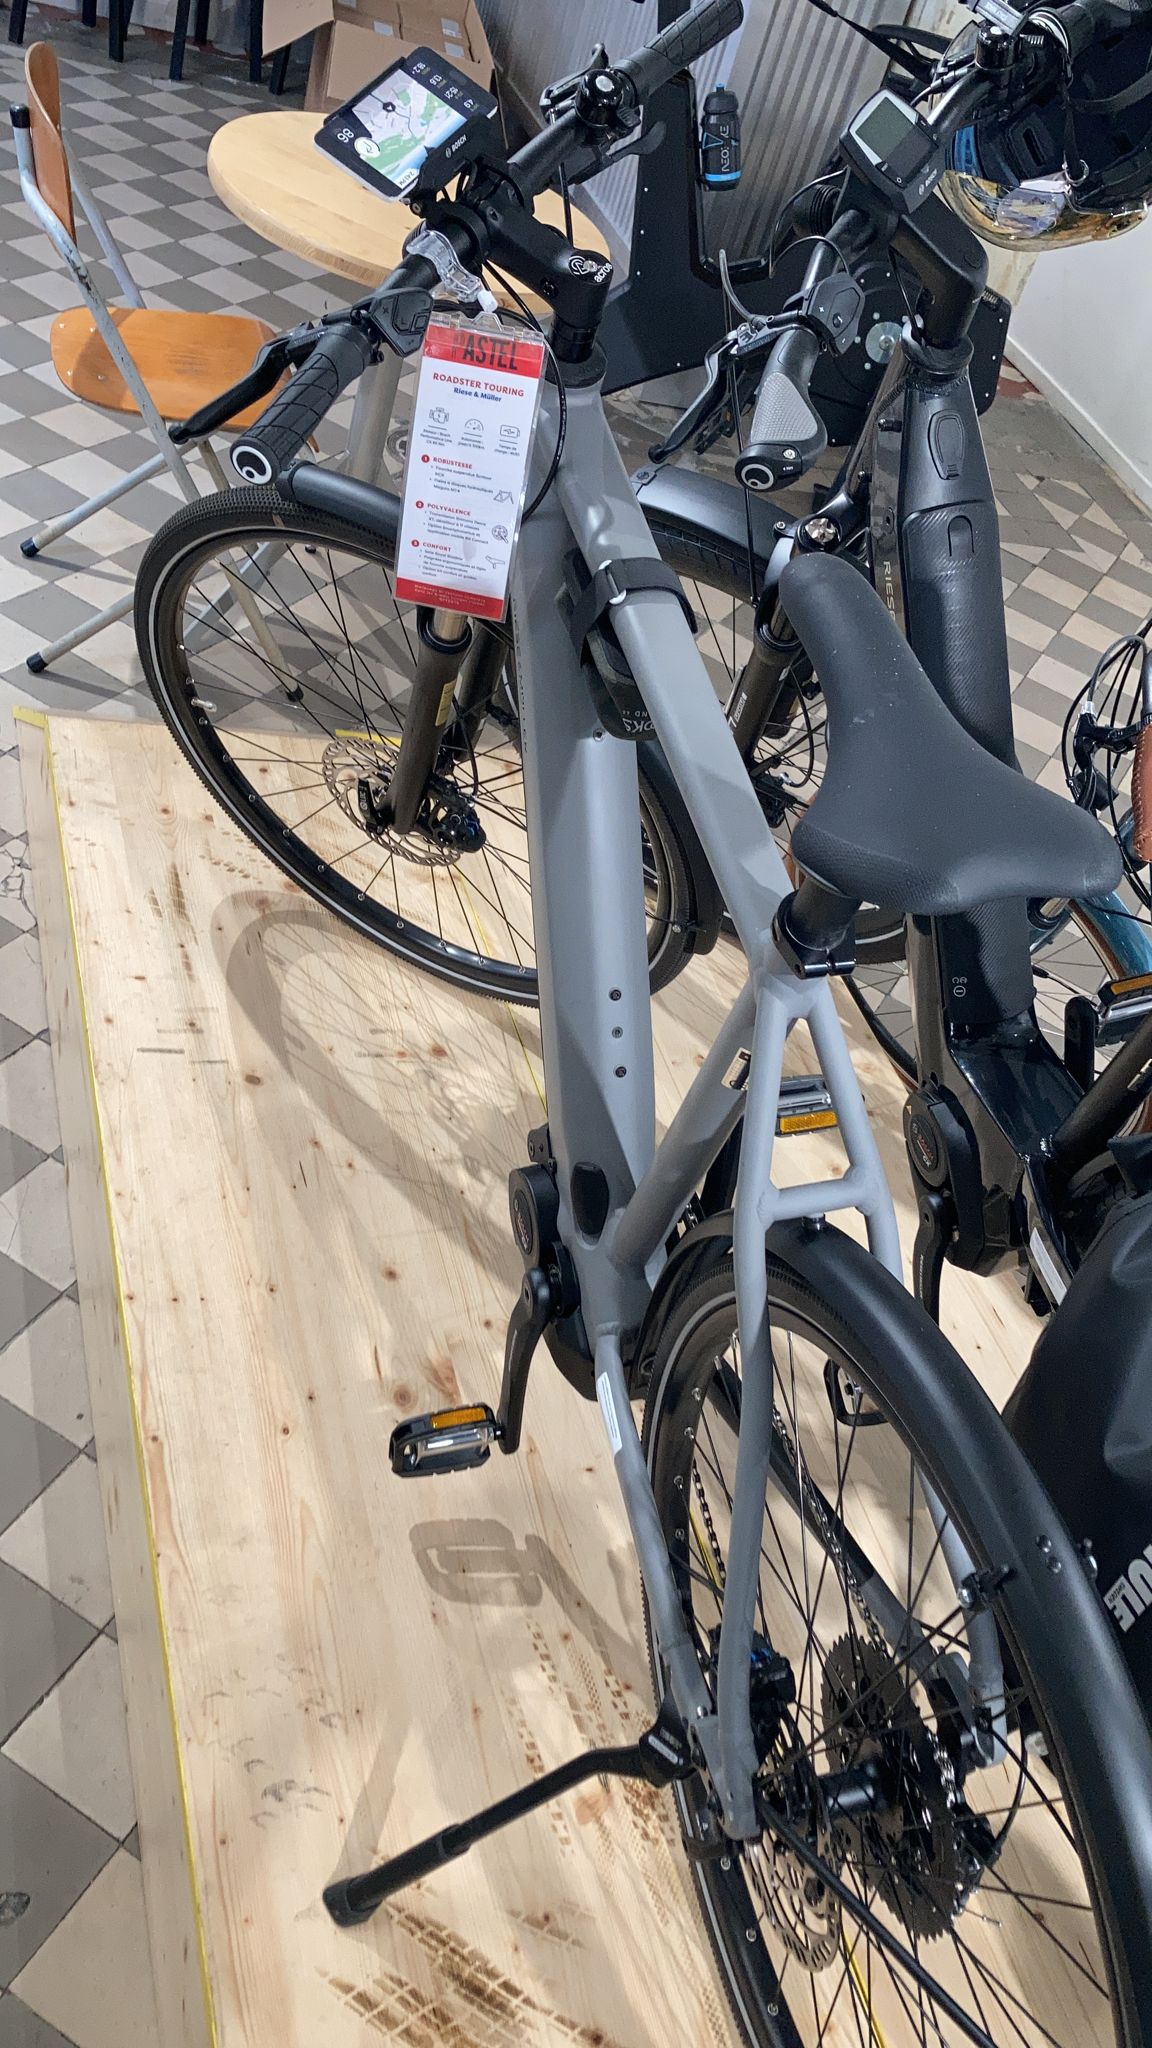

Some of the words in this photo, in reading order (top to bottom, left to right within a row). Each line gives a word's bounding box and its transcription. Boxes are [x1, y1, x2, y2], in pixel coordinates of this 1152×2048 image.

[451, 134, 468, 153] BOSCH
[451, 332, 518, 370] PASTEL
[433, 372, 482, 389] ROADSTER
[484, 382, 525, 397] TOURING
[453, 387, 473, 397] Riese
[480, 391, 502, 403] Müller
[433, 456, 473, 469] ROBUSTESSE
[427, 503, 471, 516] POLYVALENCE
[422, 542, 452, 553] CONFORT
